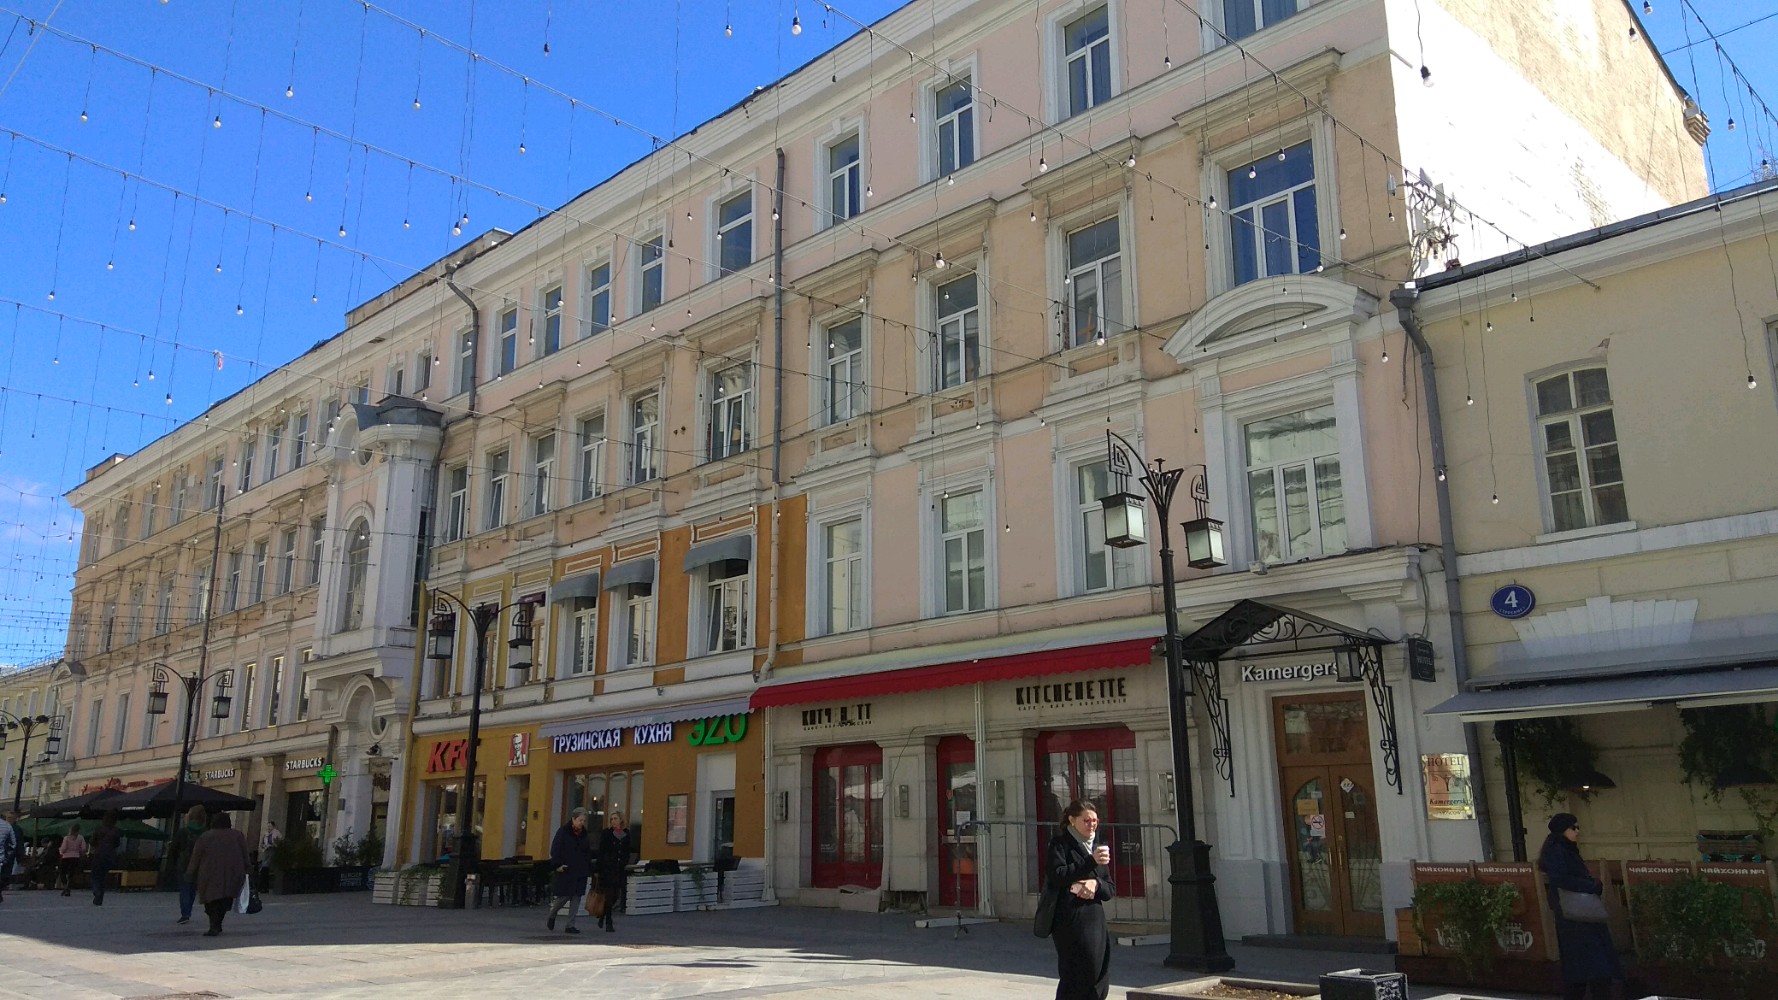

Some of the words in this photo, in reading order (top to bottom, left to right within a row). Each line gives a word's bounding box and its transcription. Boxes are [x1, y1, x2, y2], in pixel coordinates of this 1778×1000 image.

[1504, 590, 1519, 608] 4
[1015, 677, 1127, 705] KITCHENETTE
[553, 729, 621, 753] ГРУЗИНСКАЯ
[633, 722, 673, 745] КУХНЯ
[285, 757, 323, 770] STARBUCKS
[1427, 756, 1464, 767] HOTEL
[205, 768, 235, 780] STARBUCKS
